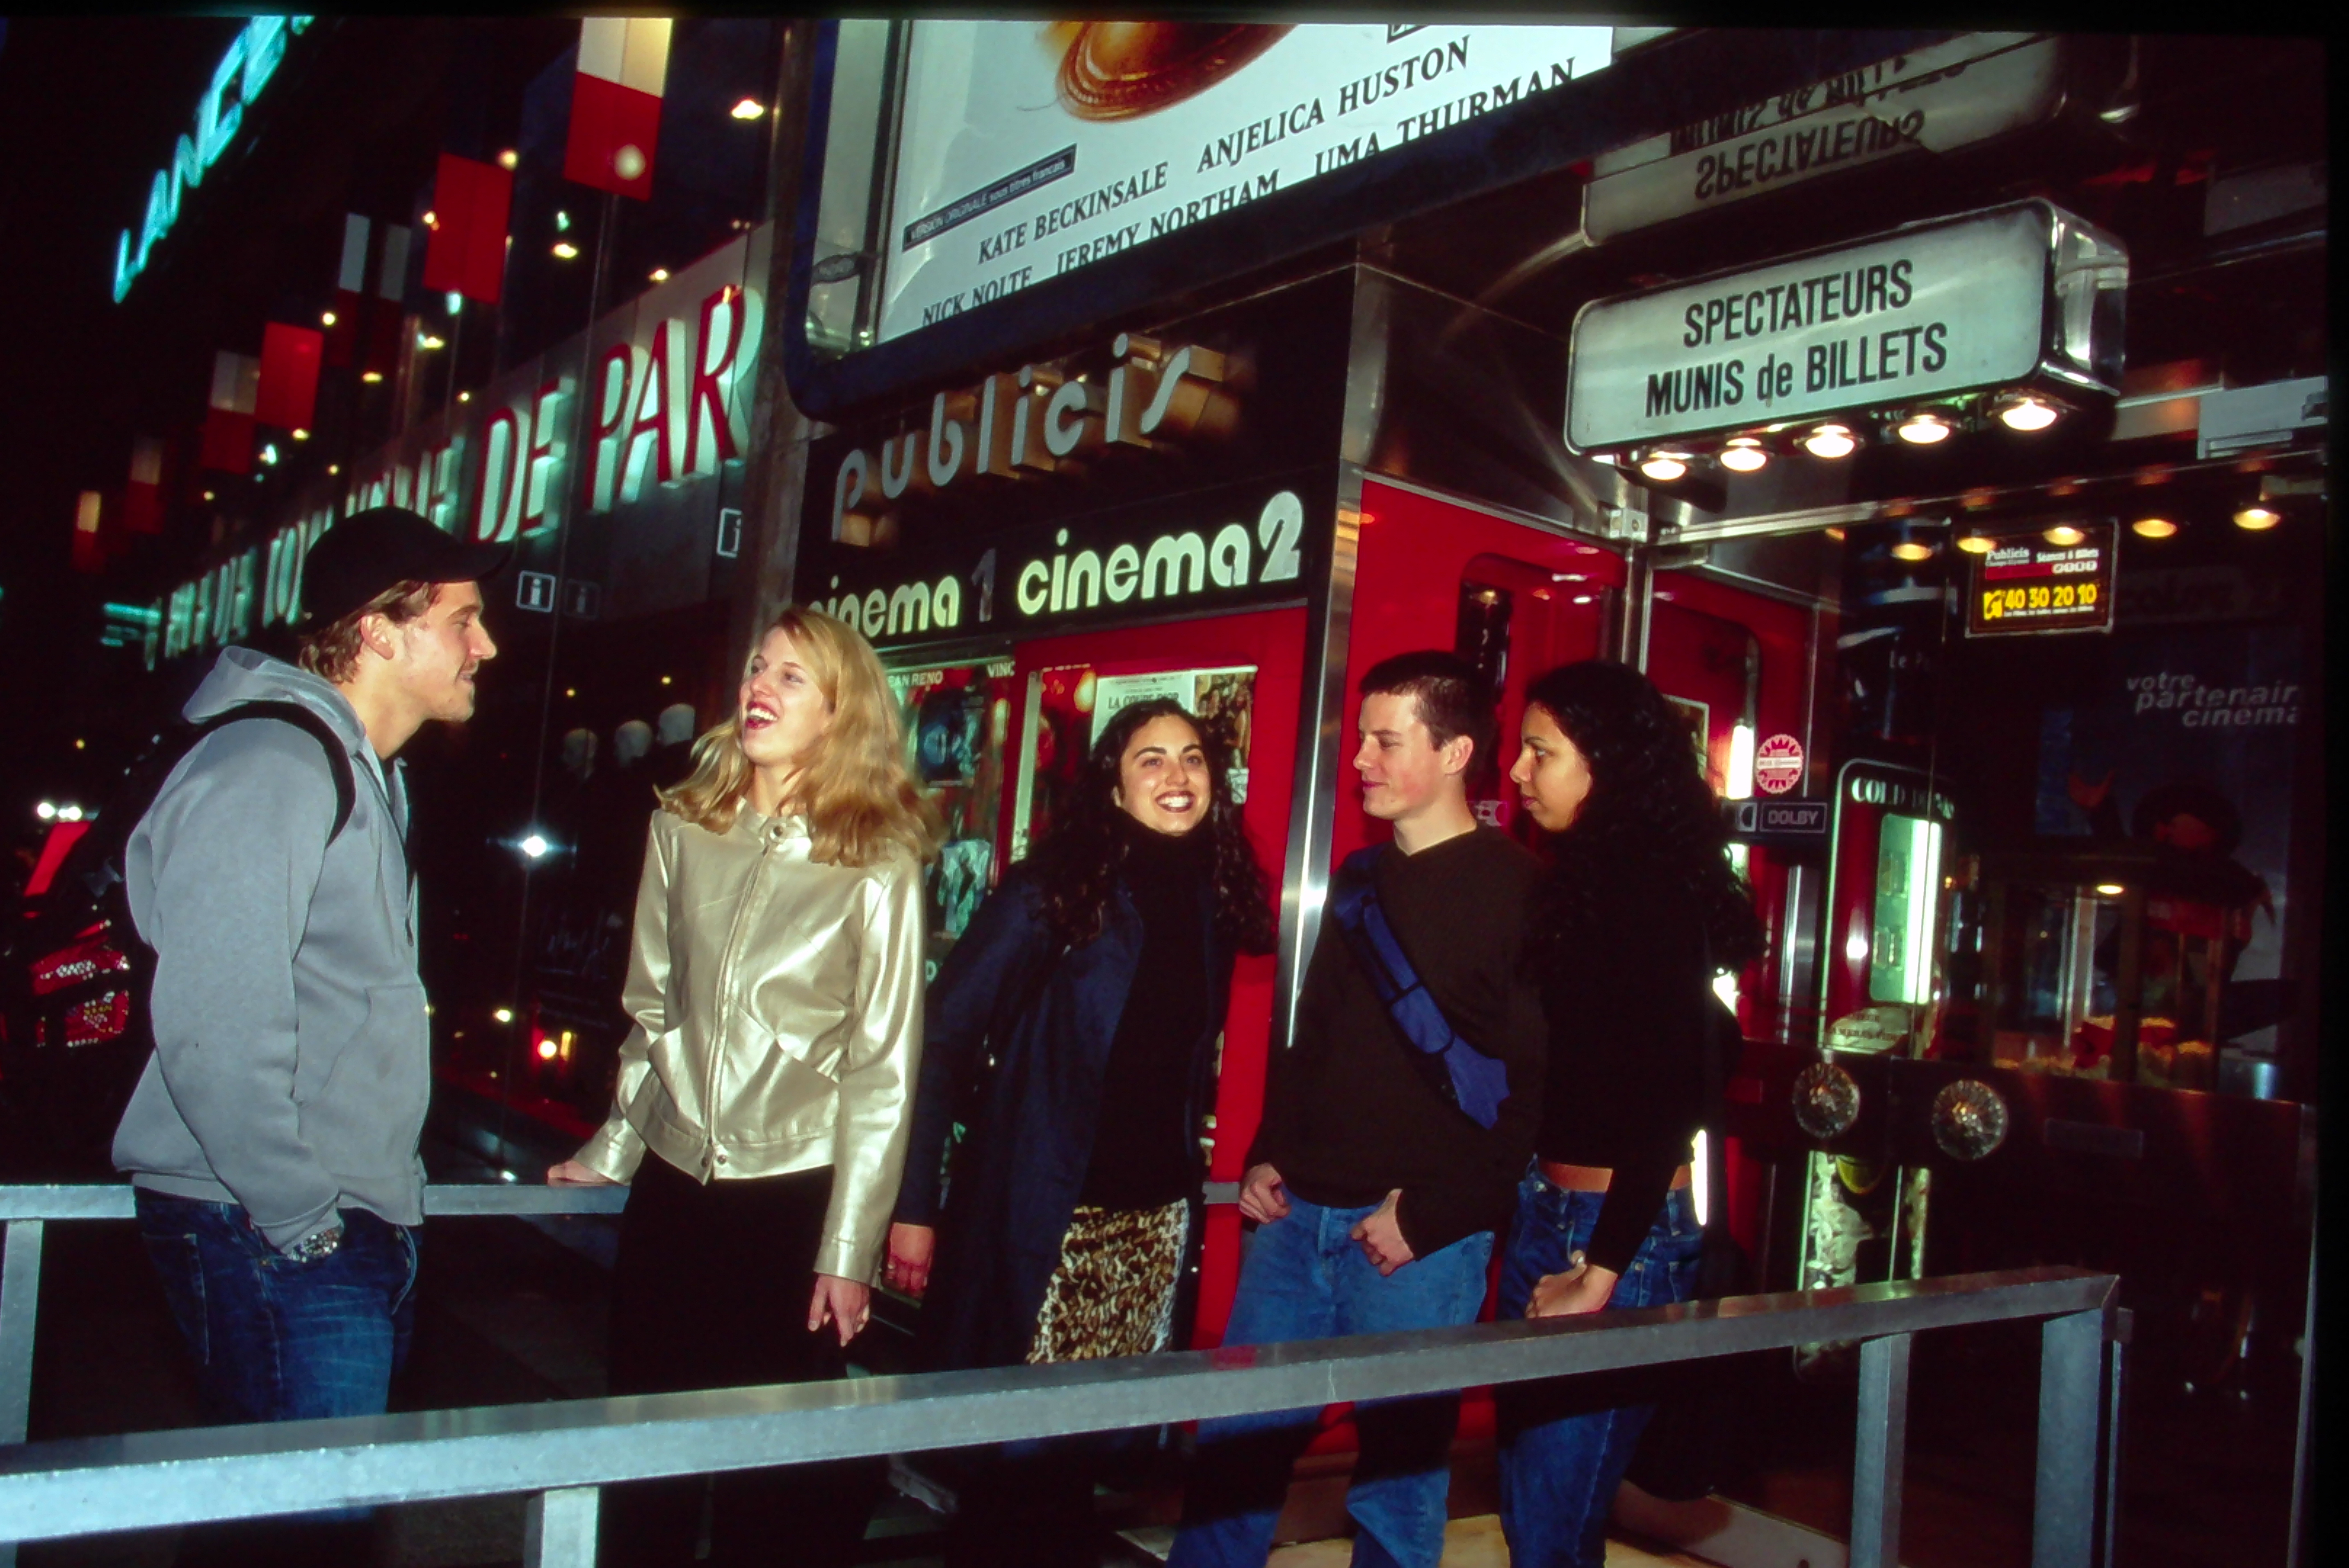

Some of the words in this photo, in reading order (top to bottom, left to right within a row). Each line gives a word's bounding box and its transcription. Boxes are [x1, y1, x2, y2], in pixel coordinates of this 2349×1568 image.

[1197, 96, 1325, 173] ANJELICA
[1337, 34, 1471, 116] HUSTON
[922, 292, 965, 326] NICK
[1149, 168, 1279, 239] NORTHAM
[1397, 57, 1576, 144] THURMAN
[978, 222, 1028, 264] KATE
[1033, 160, 1168, 241] BECKINSALE
[1683, 260, 1913, 348] SPECTATEURS
[1645, 360, 1744, 417] MUNIS
[1757, 354, 1793, 400] de
[1806, 323, 1947, 392] BILLETS
[470, 376, 574, 543] DE
[831, 331, 1195, 542] publicis
[972, 549, 996, 622] 1
[1017, 528, 1251, 615] cinema
[1258, 491, 1304, 583] 2
[2005, 588, 2026, 610] 40
[2028, 586, 2050, 609] 30
[2053, 585, 2074, 607] 20
[2077, 583, 2098, 605] 10
[911, 670, 944, 686] RENO
[2127, 672, 2195, 691] votre
[1768, 809, 1820, 825] DOLBY
[1851, 777, 1906, 805] COLD
